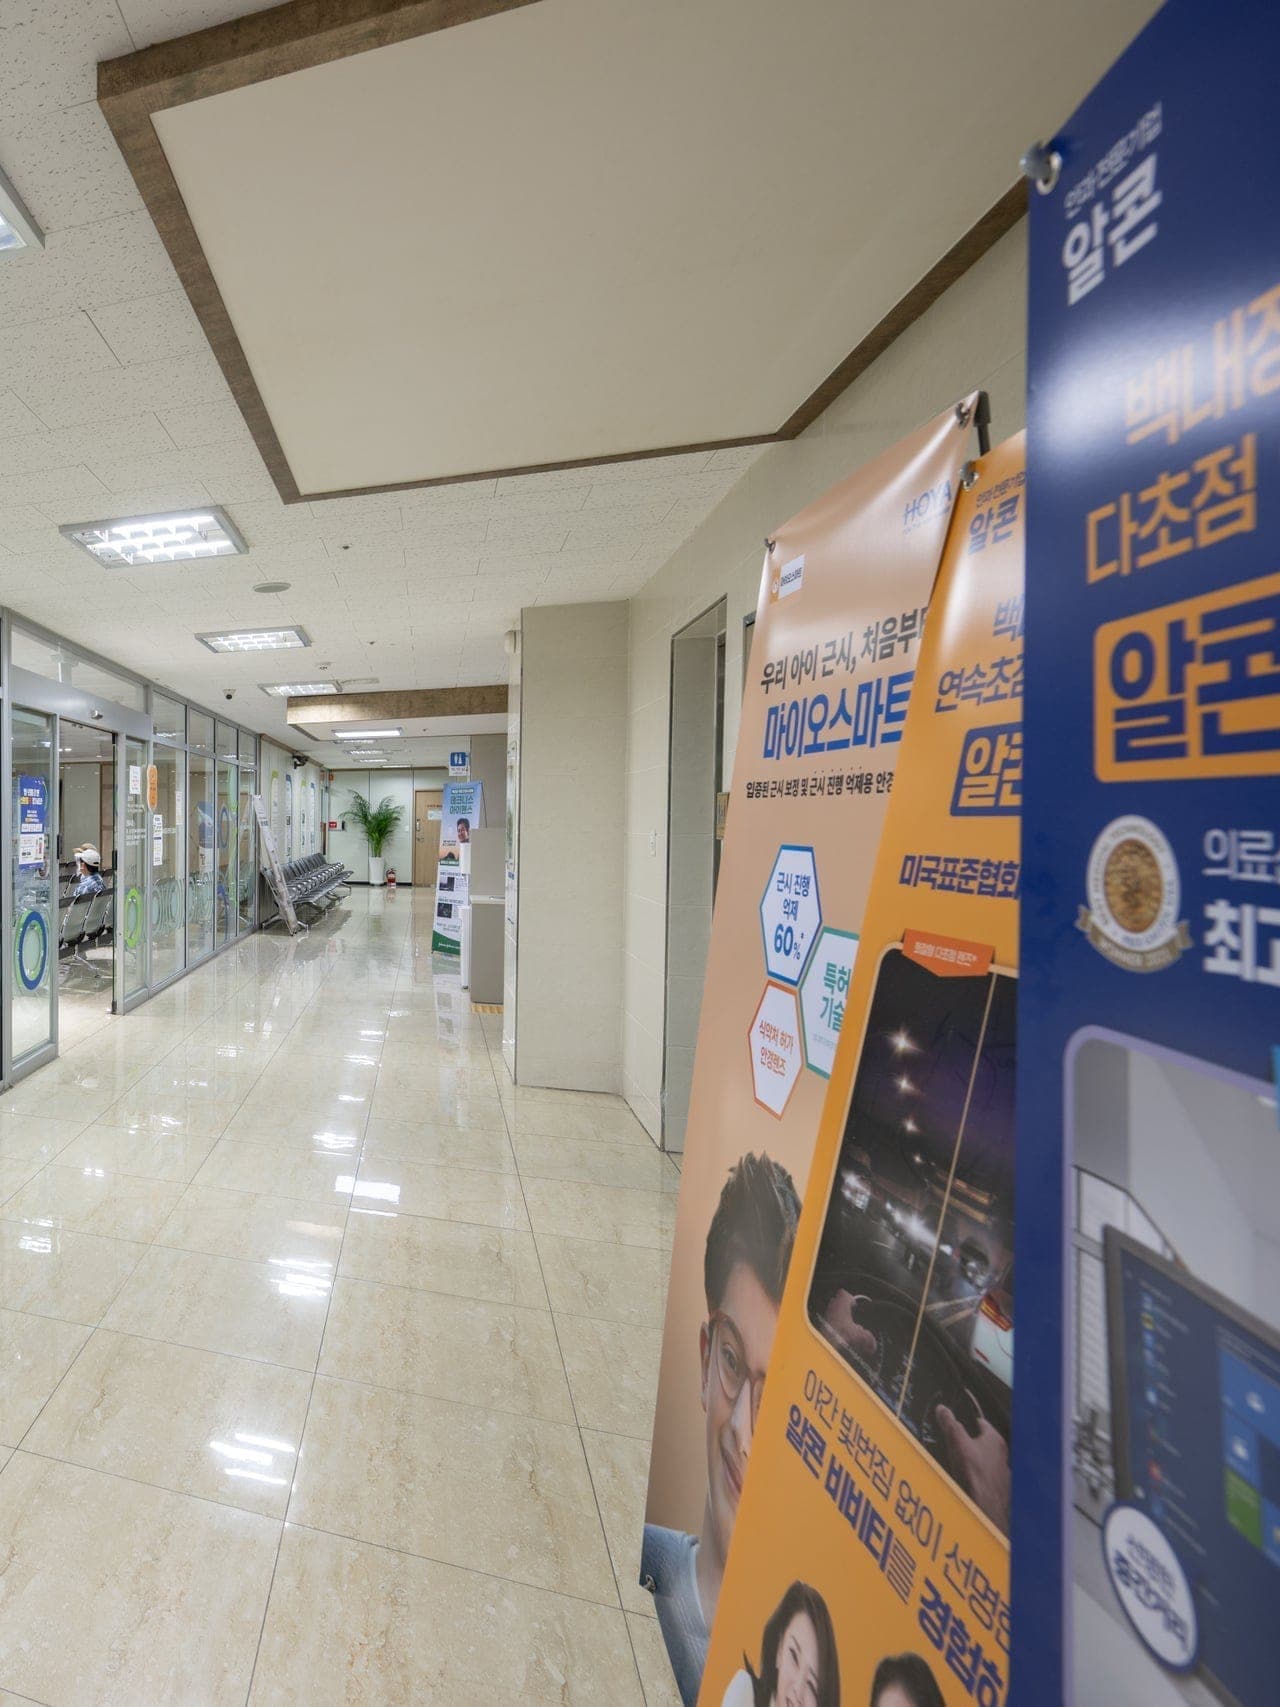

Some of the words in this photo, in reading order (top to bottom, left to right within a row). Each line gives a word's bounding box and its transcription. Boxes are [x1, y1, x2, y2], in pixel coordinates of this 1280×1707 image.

[1062, 153, 1163, 307] 알콘
[903, 479, 952, 526] HOYA
[967, 495, 1019, 555] 알콘
[1086, 432, 1257, 585] 다초점
[993, 596, 1025, 641] 백
[761, 656, 787, 694] 우리
[791, 645, 818, 685] 아이
[822, 632, 856, 674] 근시,
[763, 670, 915, 760] 마이오스마트
[746, 781, 769, 798] 입증된
[770, 779, 784, 798] 근시
[785, 778, 799, 797] 보정
[801, 778, 809, 796] 및
[810, 776, 825, 796] 근시
[827, 774, 844, 795] 진행
[846, 772, 873, 795] 억제용
[1202, 828, 1280, 884] 의료
[777, 872, 793, 894] 근시
[794, 875, 810, 897] 진행
[783, 898, 799, 921] 억제
[823, 962, 851, 1000] 특허
[759, 1019, 779, 1047] 식약처
[779, 1030, 794, 1055] 허가
[761, 1047, 786, 1076] 안경렌즈
[804, 1370, 838, 1430] 야간
[838, 1408, 895, 1500] 빛번짐
[895, 1480, 943, 1561] 없이
[786, 1404, 826, 1480] 알콘
[825, 1454, 917, 1605] 비비티를
